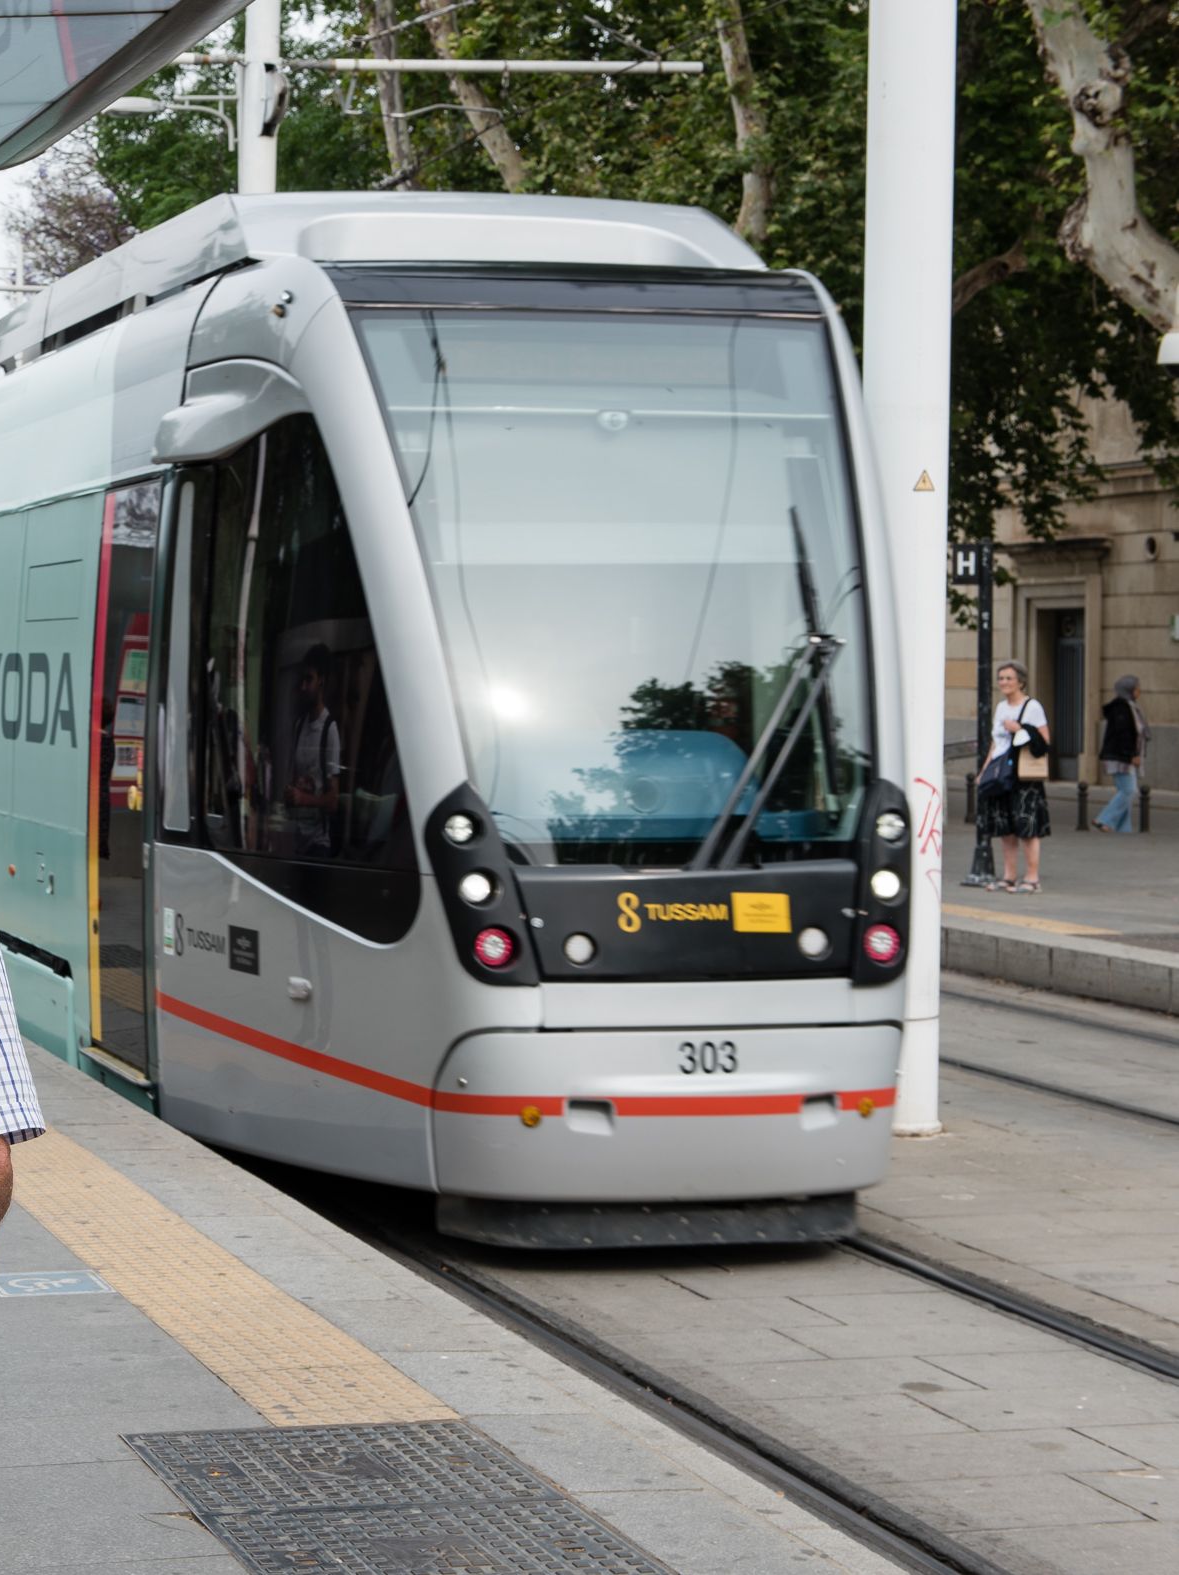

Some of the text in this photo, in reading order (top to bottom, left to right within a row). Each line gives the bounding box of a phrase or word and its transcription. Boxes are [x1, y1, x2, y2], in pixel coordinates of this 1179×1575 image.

[956, 550, 976, 577] H
[644, 902, 729, 921] TUSSAM
[186, 927, 226, 955] TUSSAM
[678, 1041, 738, 1075] 303
